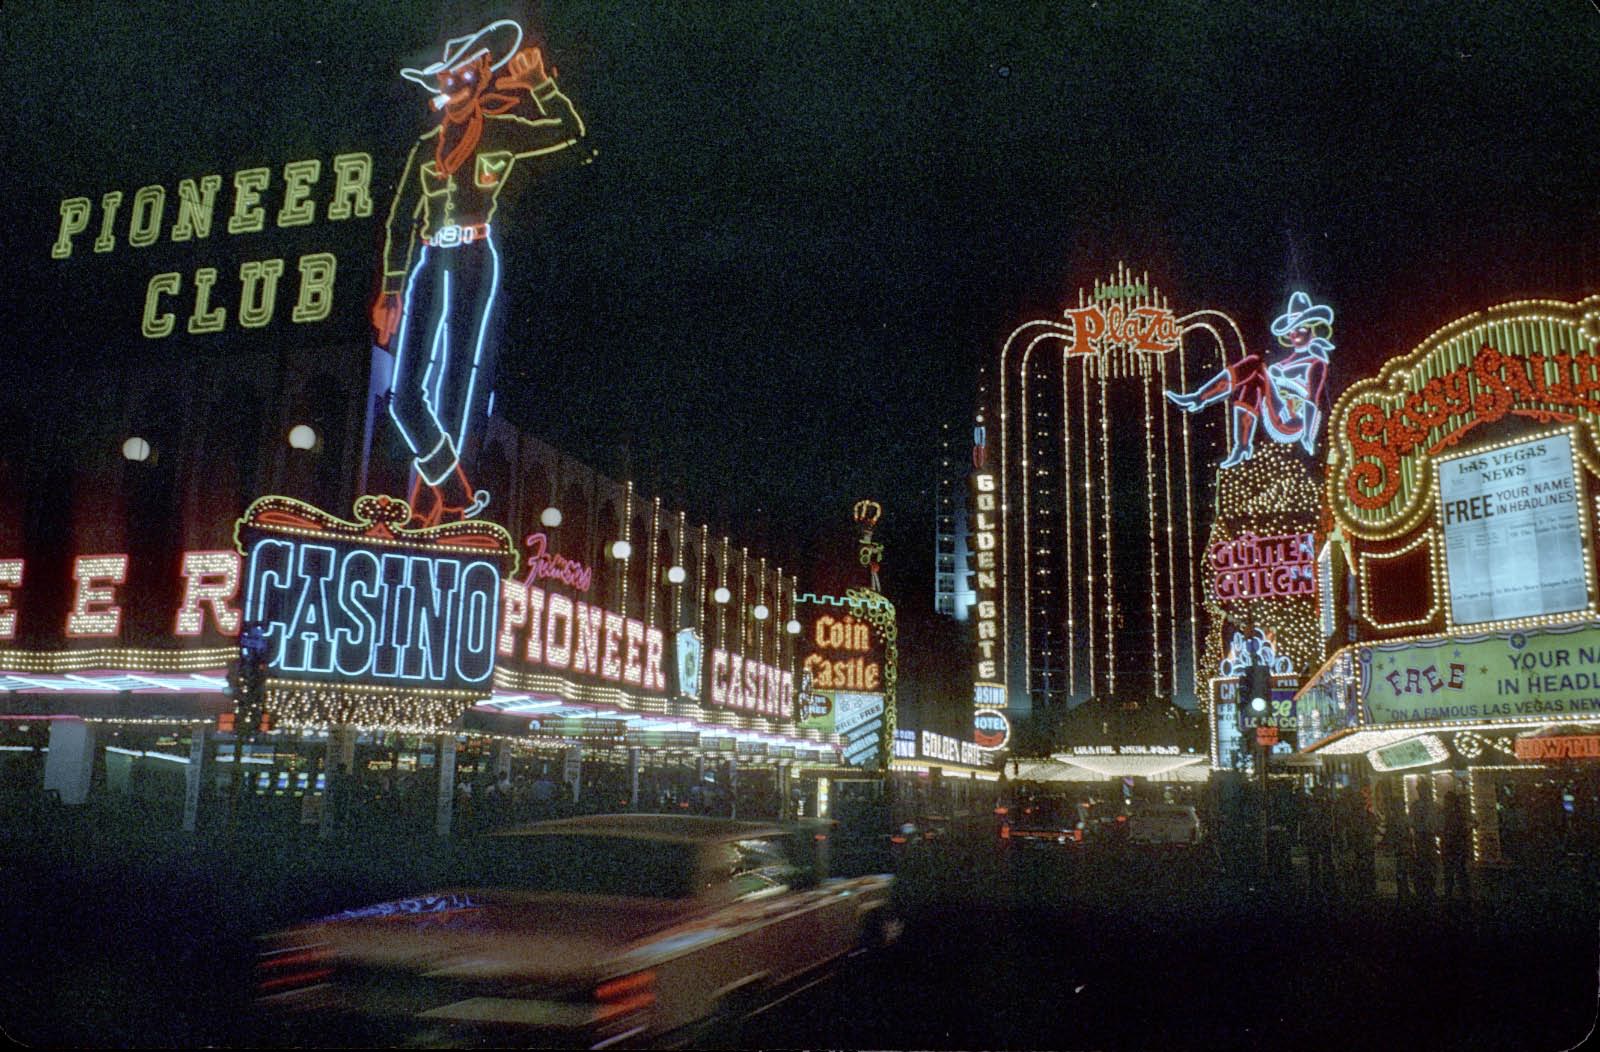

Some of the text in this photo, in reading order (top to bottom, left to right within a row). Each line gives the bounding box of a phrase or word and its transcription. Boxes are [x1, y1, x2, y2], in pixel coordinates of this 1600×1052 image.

[52, 152, 373, 258] PIONEER
[142, 253, 336, 338] CLUB
[1064, 304, 1181, 357] Plaza
[1458, 444, 1547, 474] LAS VEGAS
[1481, 465, 1526, 484] NEWS
[1495, 477, 1572, 502] YOUR NAME
[1496, 490, 1574, 515] IN HEADLINES
[1445, 494, 1494, 525] FREE
[977, 474, 996, 590] GOLDEN
[1215, 565, 1314, 600] GULCH
[245, 539, 500, 682] CASINO
[497, 577, 666, 691] PIONEER
[815, 615, 871, 651] Coin
[804, 653, 880, 689] Castle
[1508, 647, 1600, 670] YOUR N
[711, 648, 793, 719] CASINO
[974, 686, 1006, 704] ASINO
[1385, 662, 1465, 696] FREE
[1497, 678, 1520, 695] IN
[1424, 704, 1478, 720] FAMOUS
[1483, 703, 1511, 715] LAS
[1515, 699, 1564, 714] VEGAS
